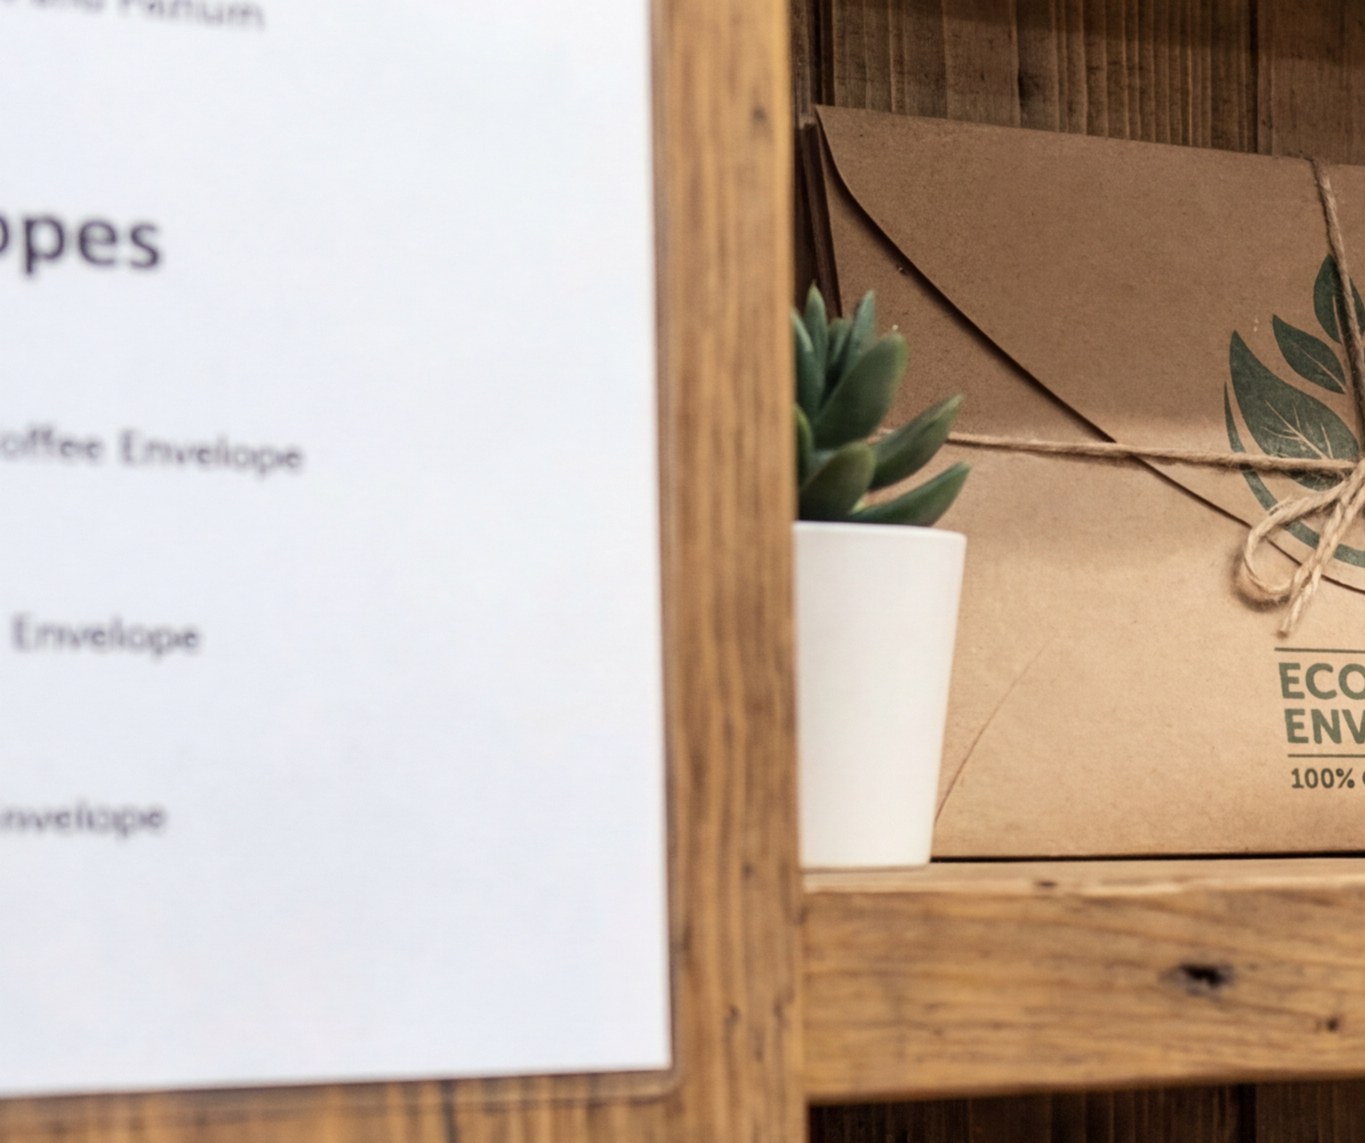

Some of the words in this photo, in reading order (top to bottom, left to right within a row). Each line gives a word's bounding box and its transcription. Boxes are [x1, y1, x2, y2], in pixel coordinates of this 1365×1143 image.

[117, 427, 306, 479] Envelope
[12, 611, 204, 664] Envelope
[1291, 767, 1355, 789] 100%
[0, 795, 168, 845] nvelope
